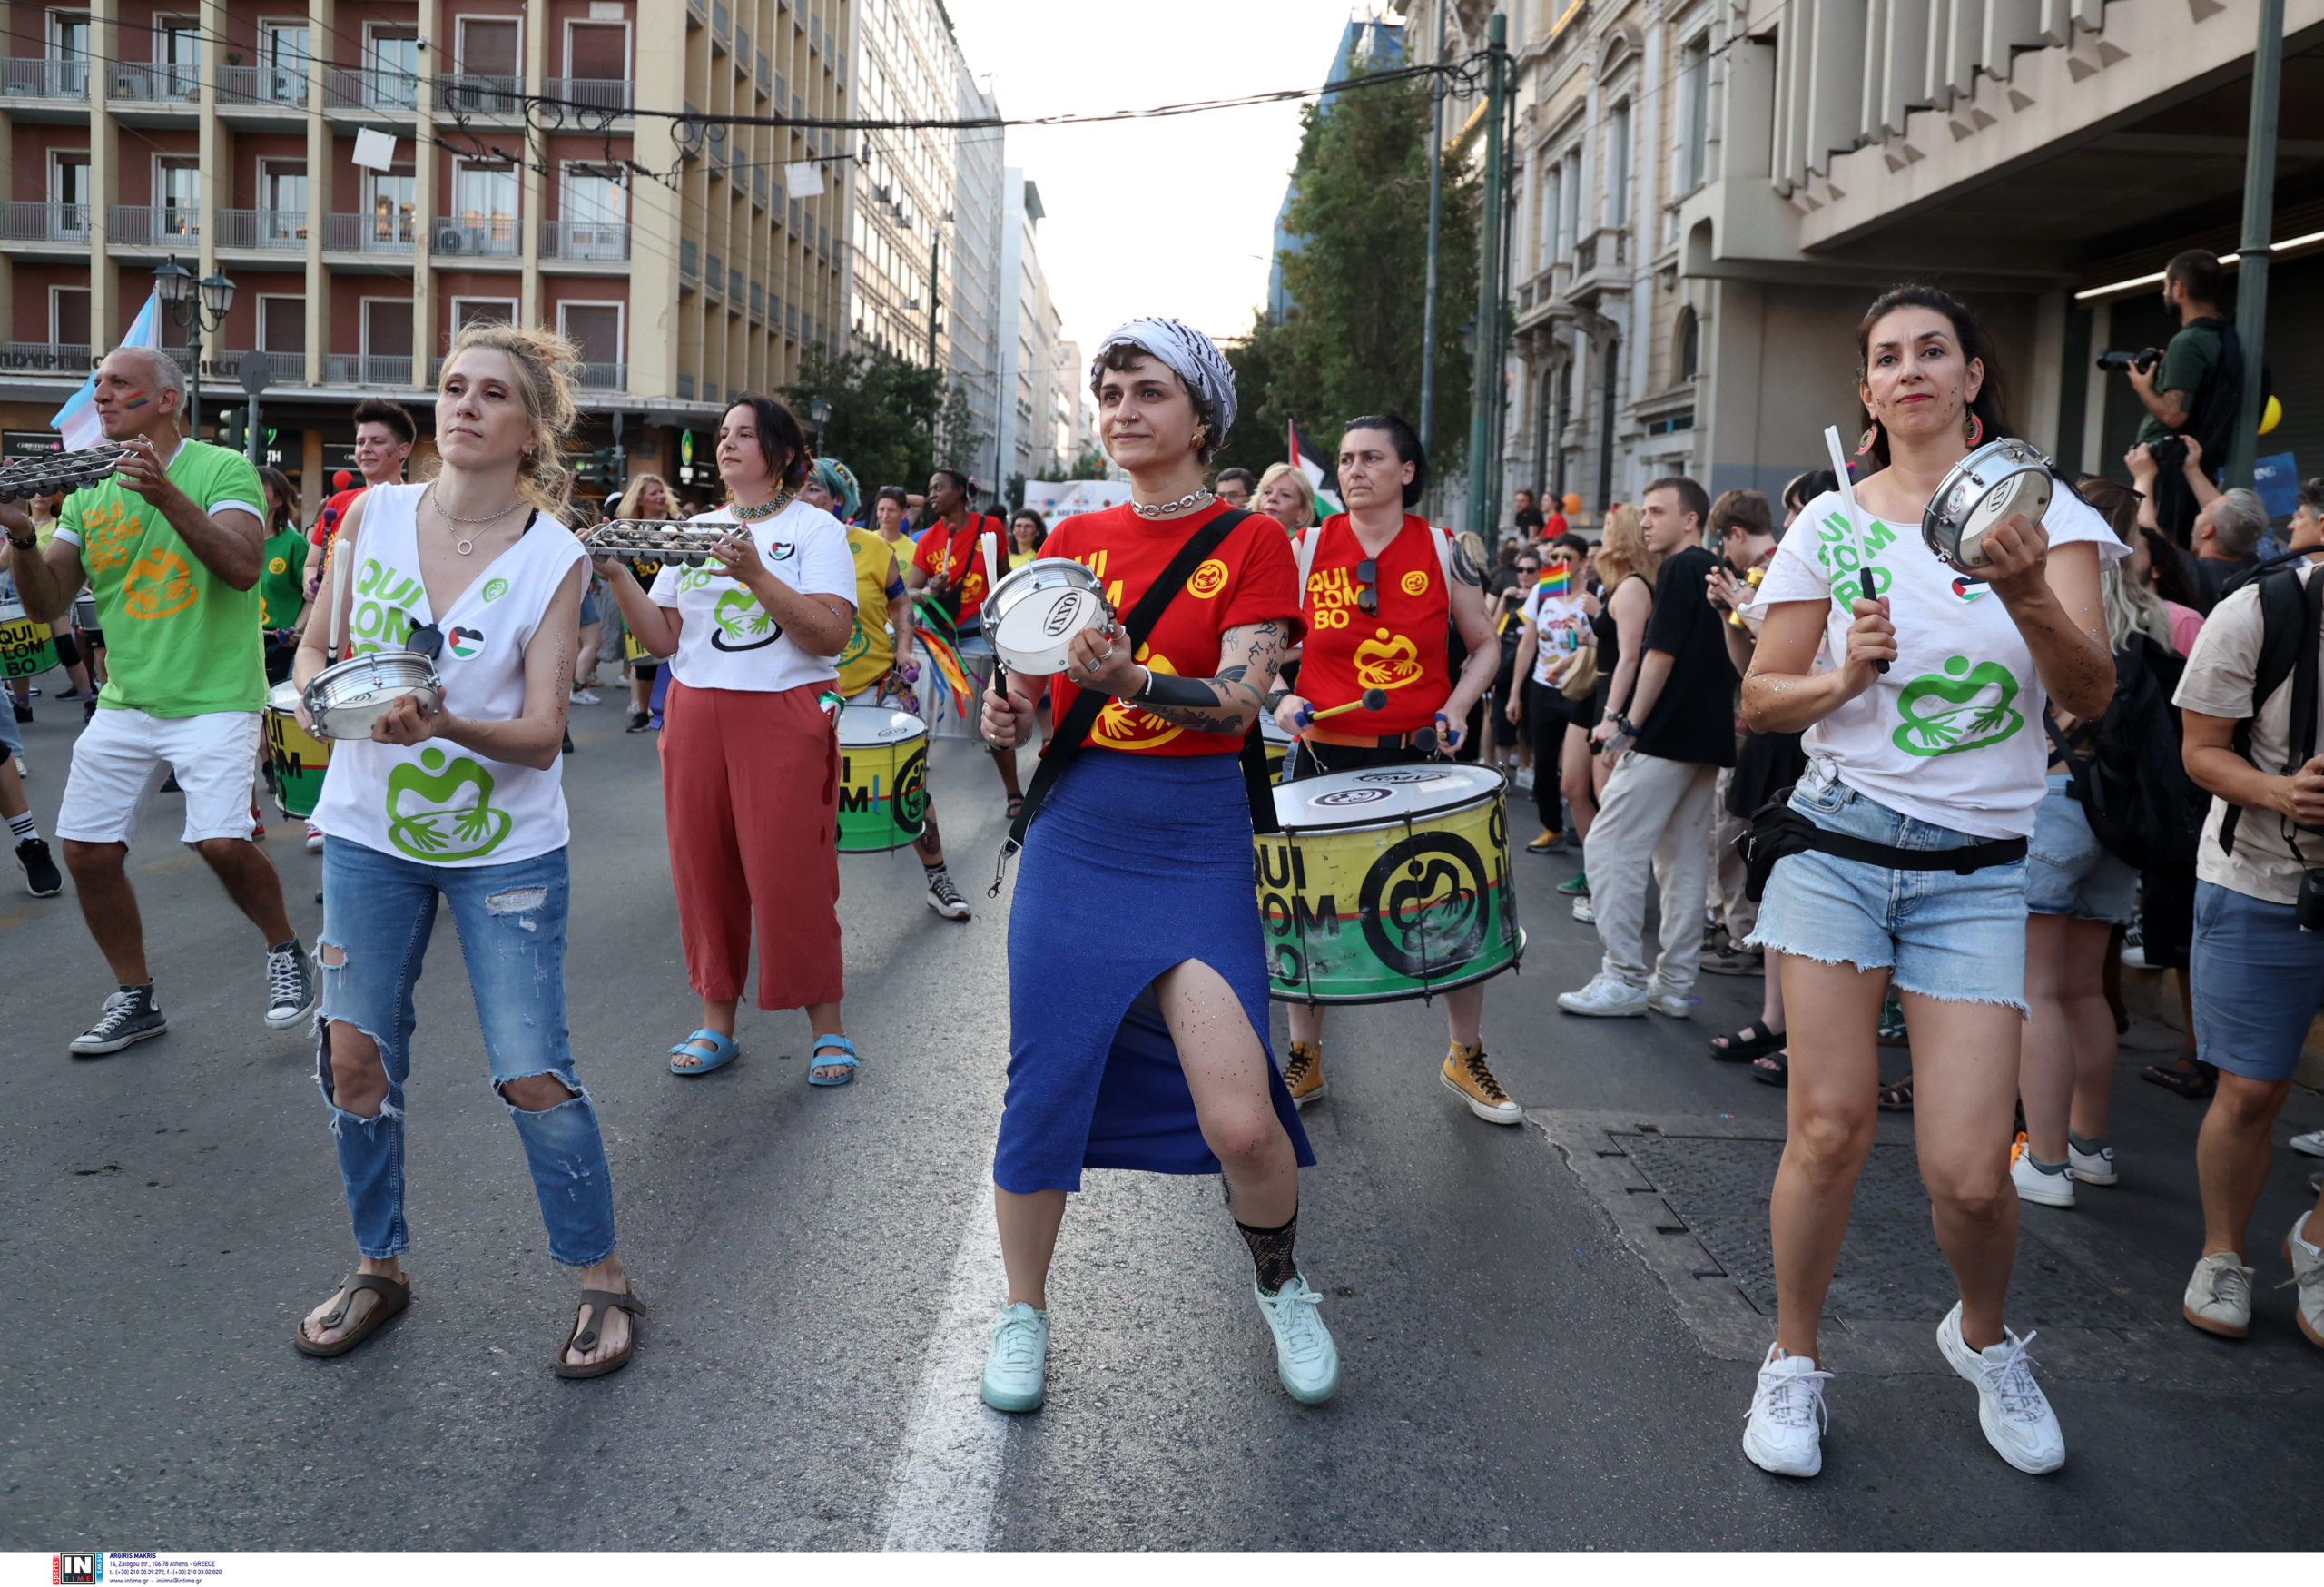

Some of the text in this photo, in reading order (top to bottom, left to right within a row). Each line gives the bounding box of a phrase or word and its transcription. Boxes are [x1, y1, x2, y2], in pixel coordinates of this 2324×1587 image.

[82, 499, 124, 528] QUI
[85, 516, 143, 550] LOM
[89, 546, 128, 573] BO
[356, 558, 424, 609] QUI
[1307, 567, 1349, 592] QUI
[1047, 597, 1077, 633] IZZO
[1314, 609, 1350, 629] BO
[0, 625, 33, 645] QUI
[2, 637, 44, 660] LOM
[6, 658, 36, 676] BO
